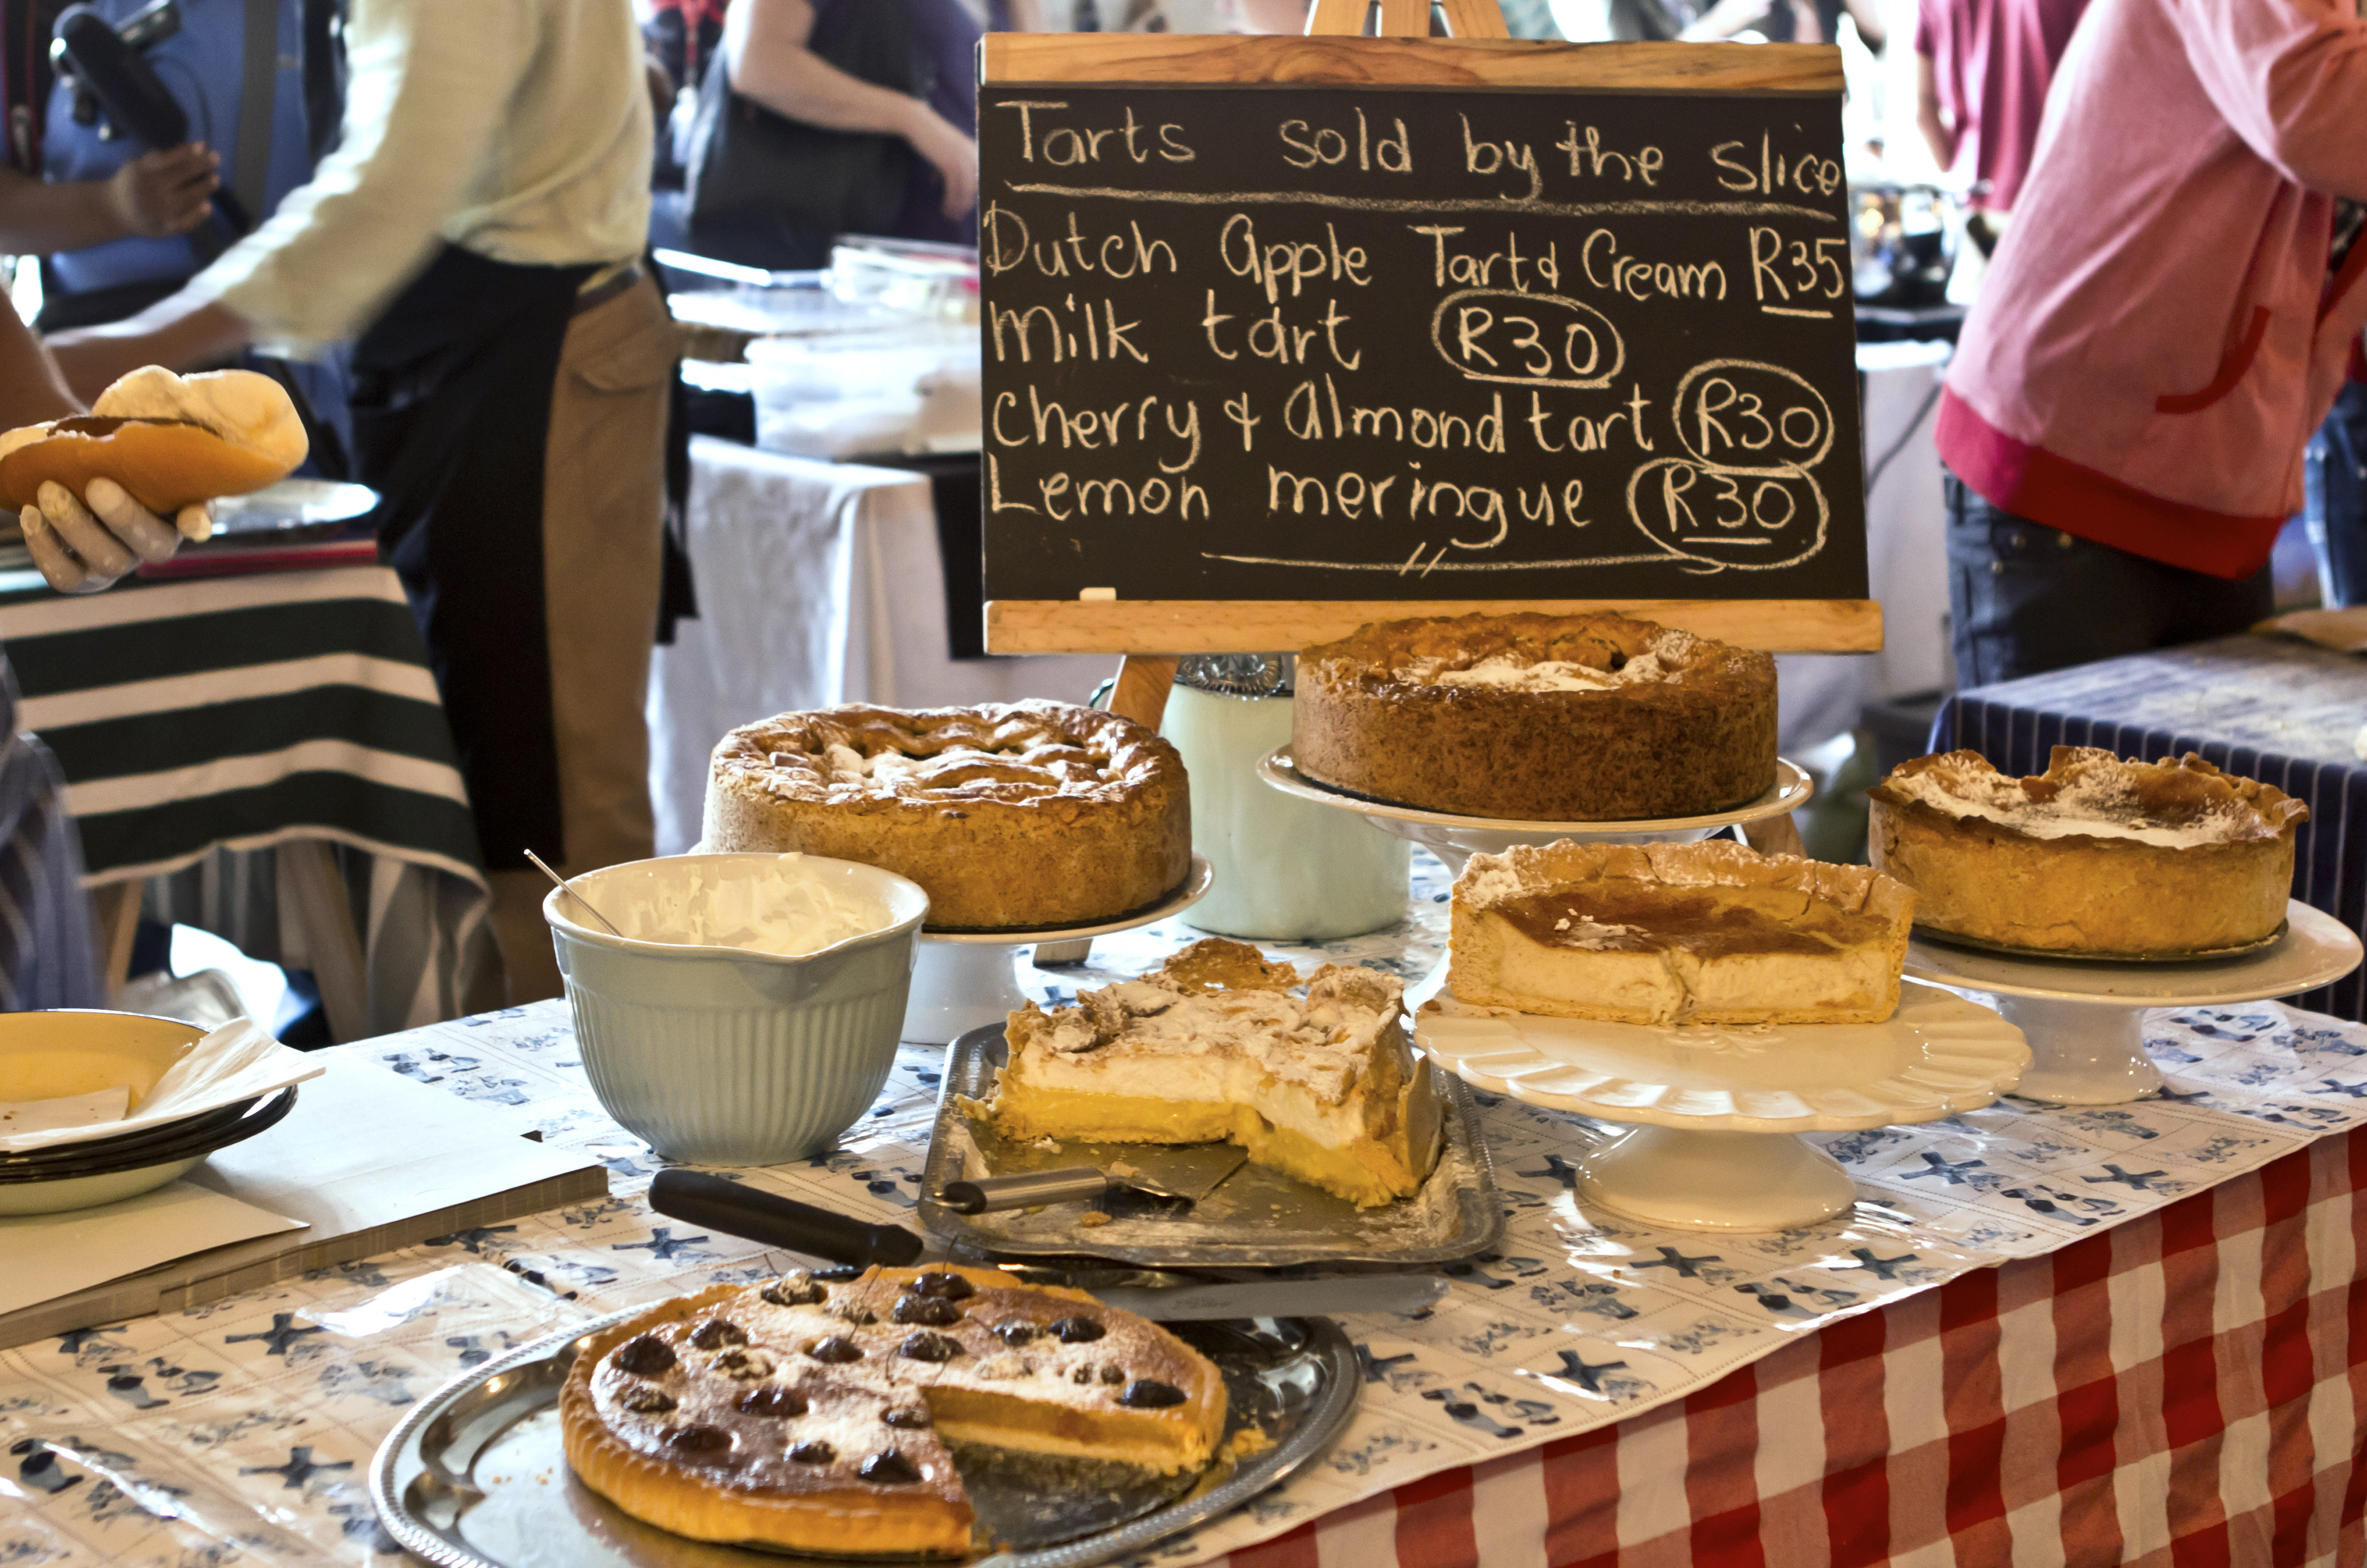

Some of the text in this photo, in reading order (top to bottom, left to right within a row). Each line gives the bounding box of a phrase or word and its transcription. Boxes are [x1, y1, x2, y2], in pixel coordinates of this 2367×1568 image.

[995, 101, 1195, 166] Tarts
[1460, 112, 1543, 202] by
[1556, 120, 1664, 186] the
[983, 200, 1176, 278] Dutch
[1582, 228, 1727, 301] Cream
[1749, 227, 1846, 300] R35
[1201, 289, 1361, 370] tart
[1459, 306, 1599, 375] R30
[1528, 383, 1654, 451] tart
[1697, 378, 1820, 455] R30
[987, 452, 1796, 549] Lemon meringue R30
